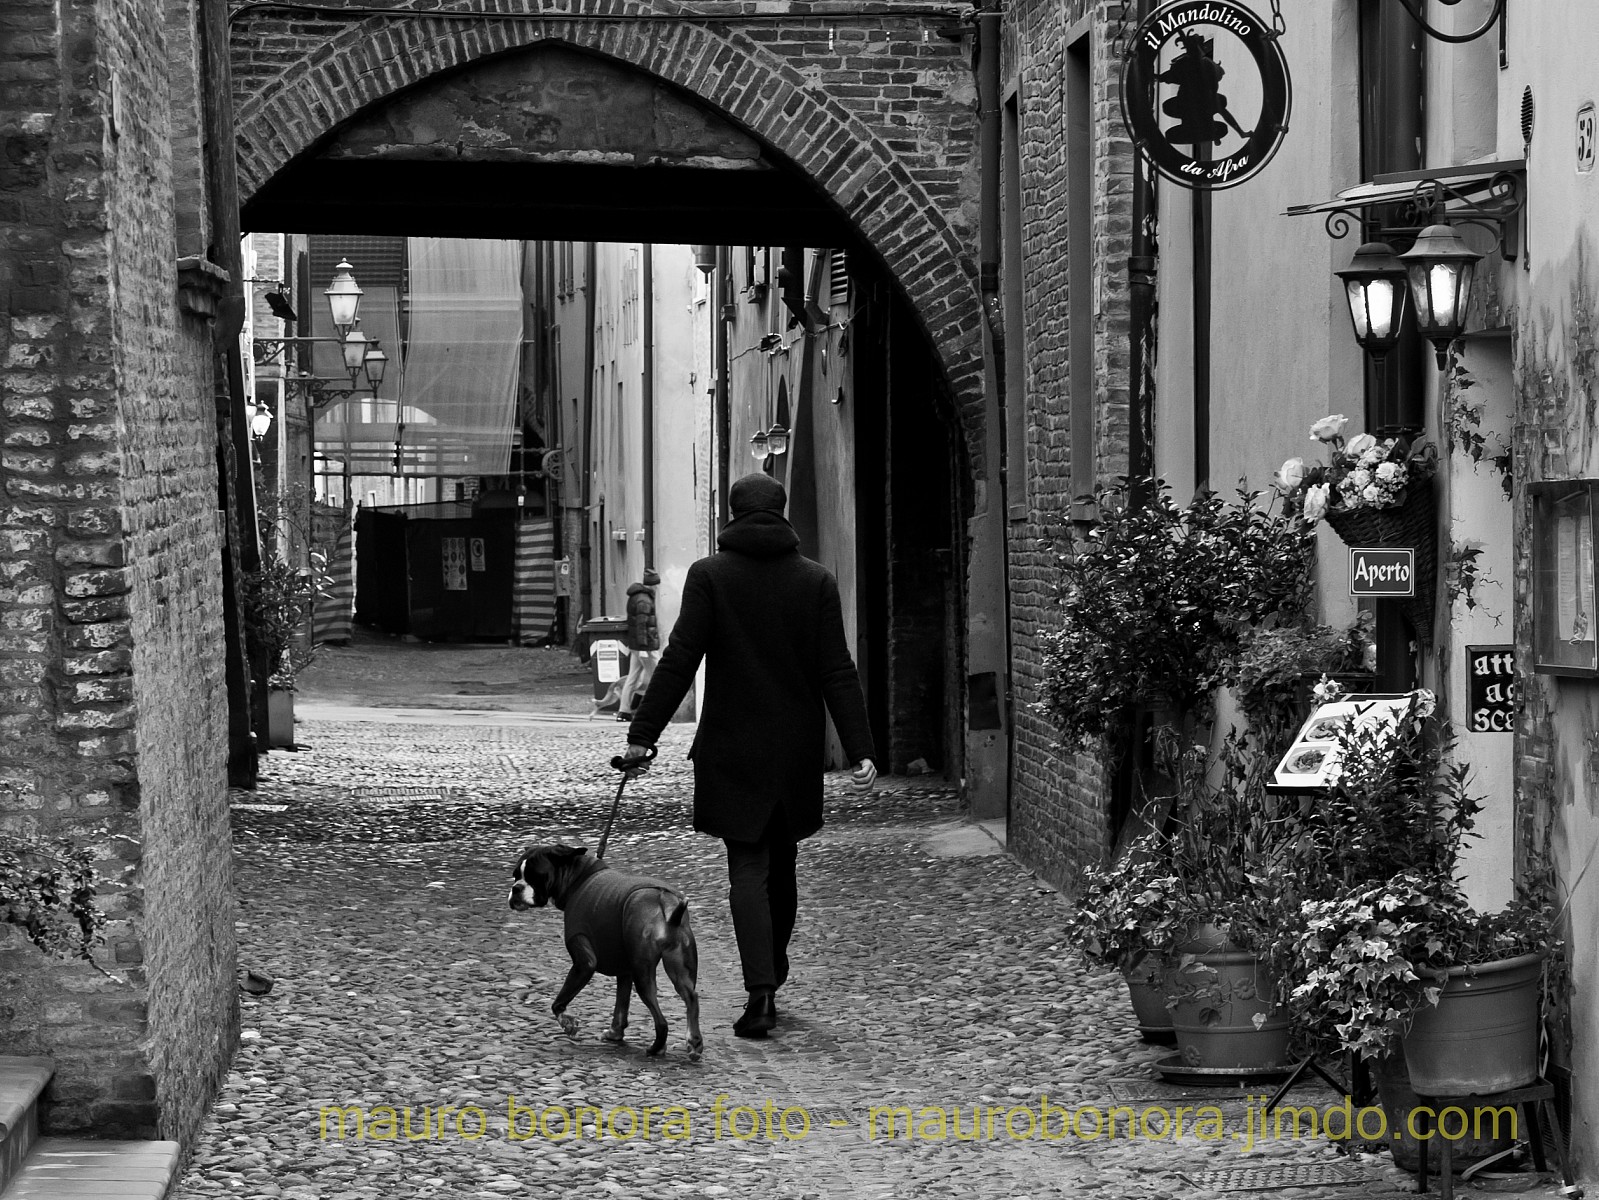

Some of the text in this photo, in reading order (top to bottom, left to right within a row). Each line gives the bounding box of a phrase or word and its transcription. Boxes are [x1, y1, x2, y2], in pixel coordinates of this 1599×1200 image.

[1144, 3, 1251, 50] il Mandolino
[1578, 117, 1593, 161] 52
[1180, 155, 1249, 182] da Afra
[1354, 556, 1410, 588] Aperto
